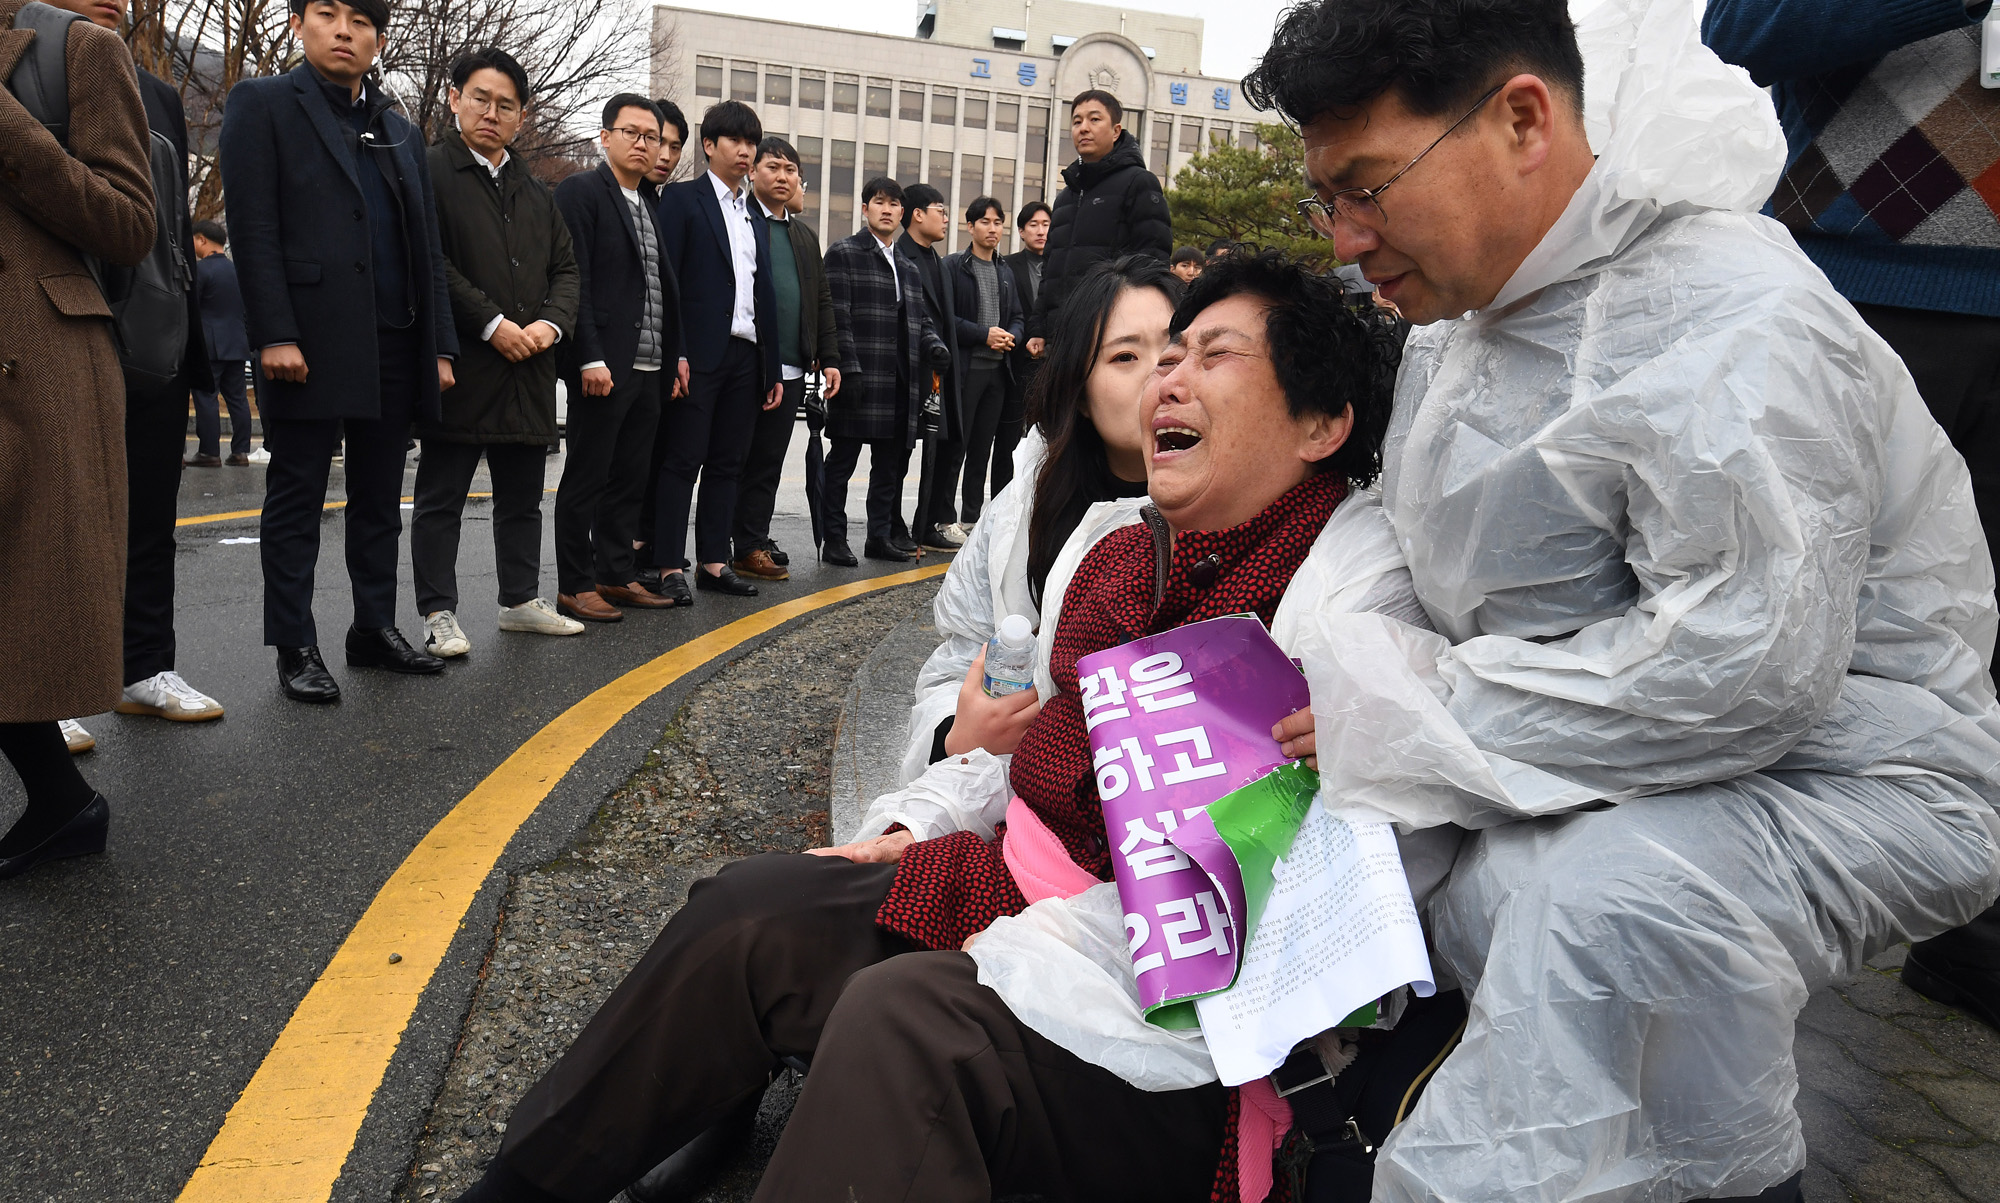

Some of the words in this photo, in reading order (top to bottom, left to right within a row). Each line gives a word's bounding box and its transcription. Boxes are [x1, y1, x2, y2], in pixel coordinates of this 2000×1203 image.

[970, 58, 1038, 86] 고등
[1170, 82, 1232, 110] 법원
[1093, 726, 1227, 801] 하고
[1118, 804, 1208, 880] 심
